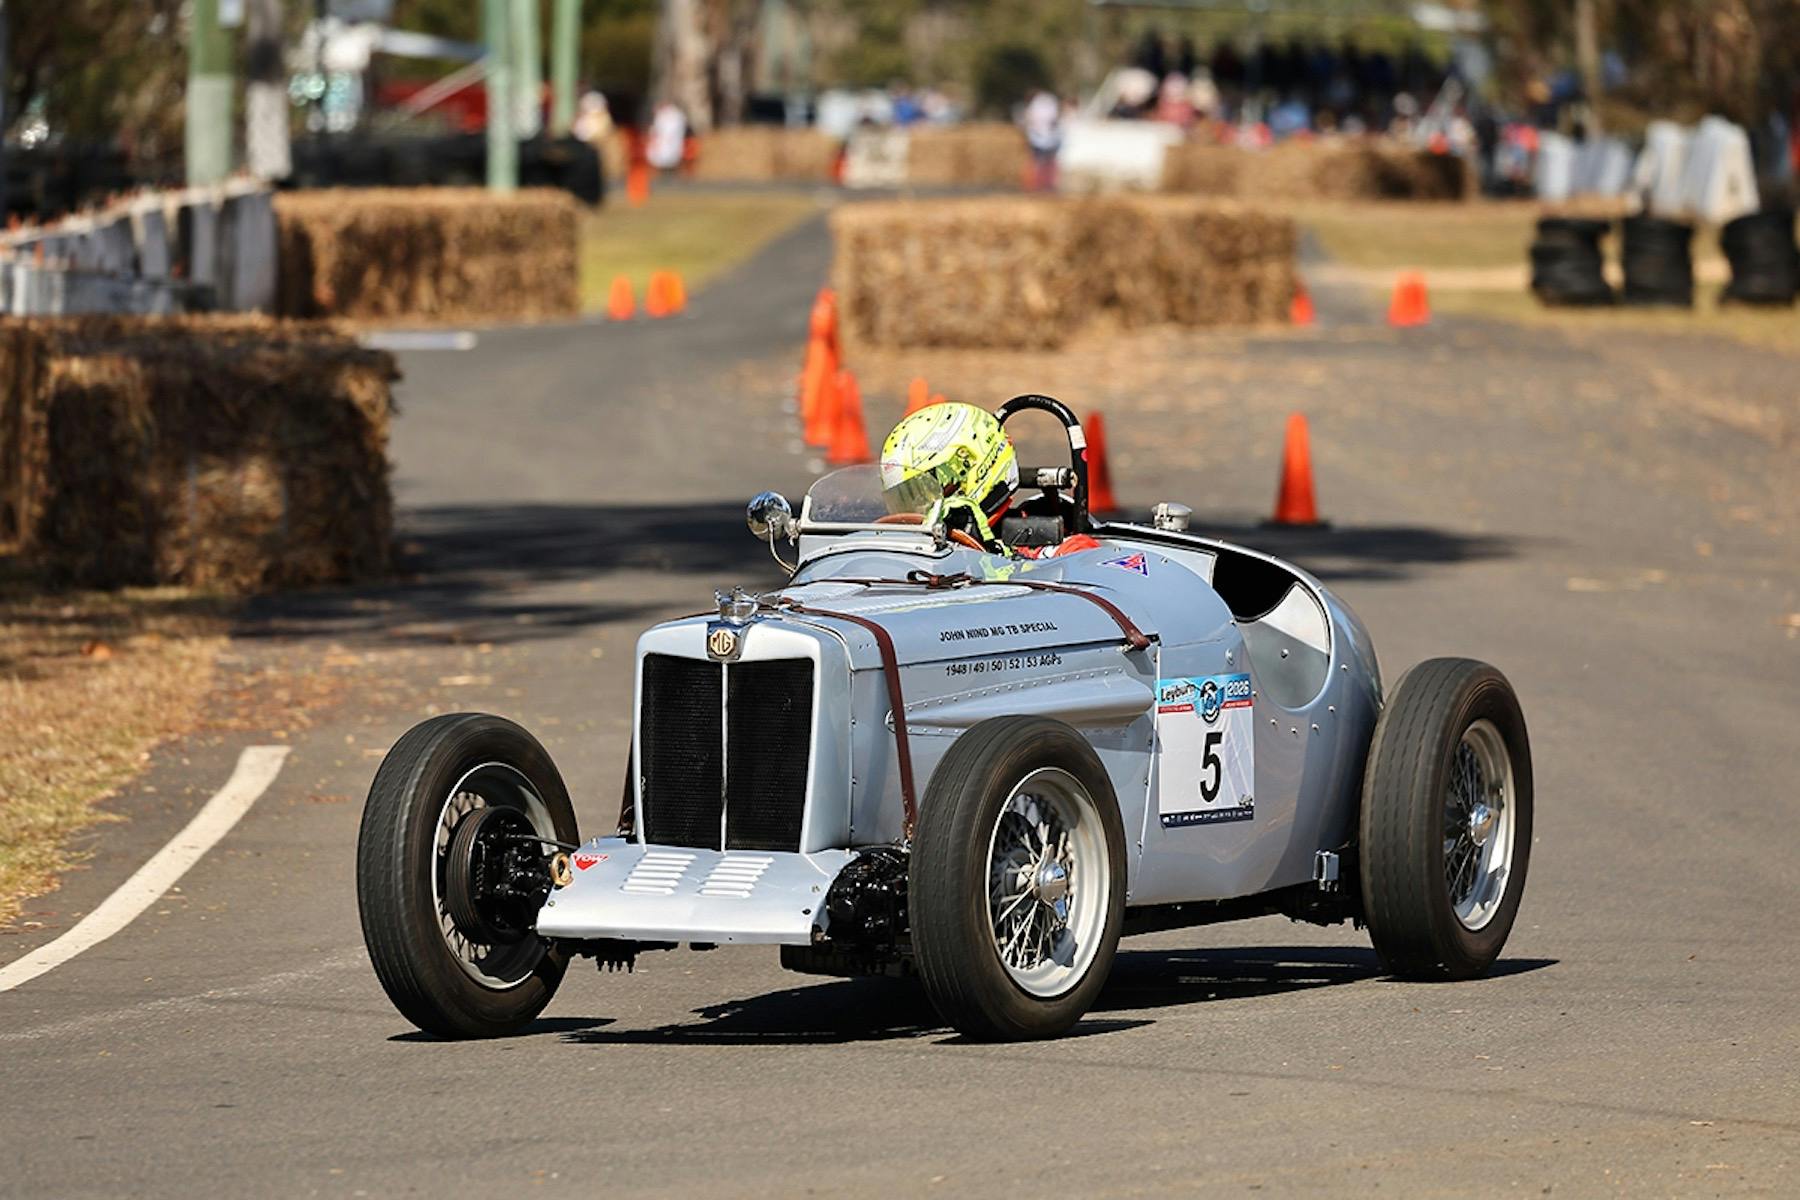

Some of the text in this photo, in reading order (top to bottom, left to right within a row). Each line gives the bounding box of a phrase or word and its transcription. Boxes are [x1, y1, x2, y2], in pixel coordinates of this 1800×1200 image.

[940, 621, 1058, 641] JOHN NIND MG TB SPECIAL
[711, 630, 734, 655] MG
[945, 663, 967, 676] 1948
[974, 661, 985, 673] 49
[991, 660, 1003, 672] 50
[1009, 658, 1021, 669] 52
[1027, 656, 1038, 668] 53
[1200, 731, 1222, 803] 5
[573, 853, 608, 863] TOW
